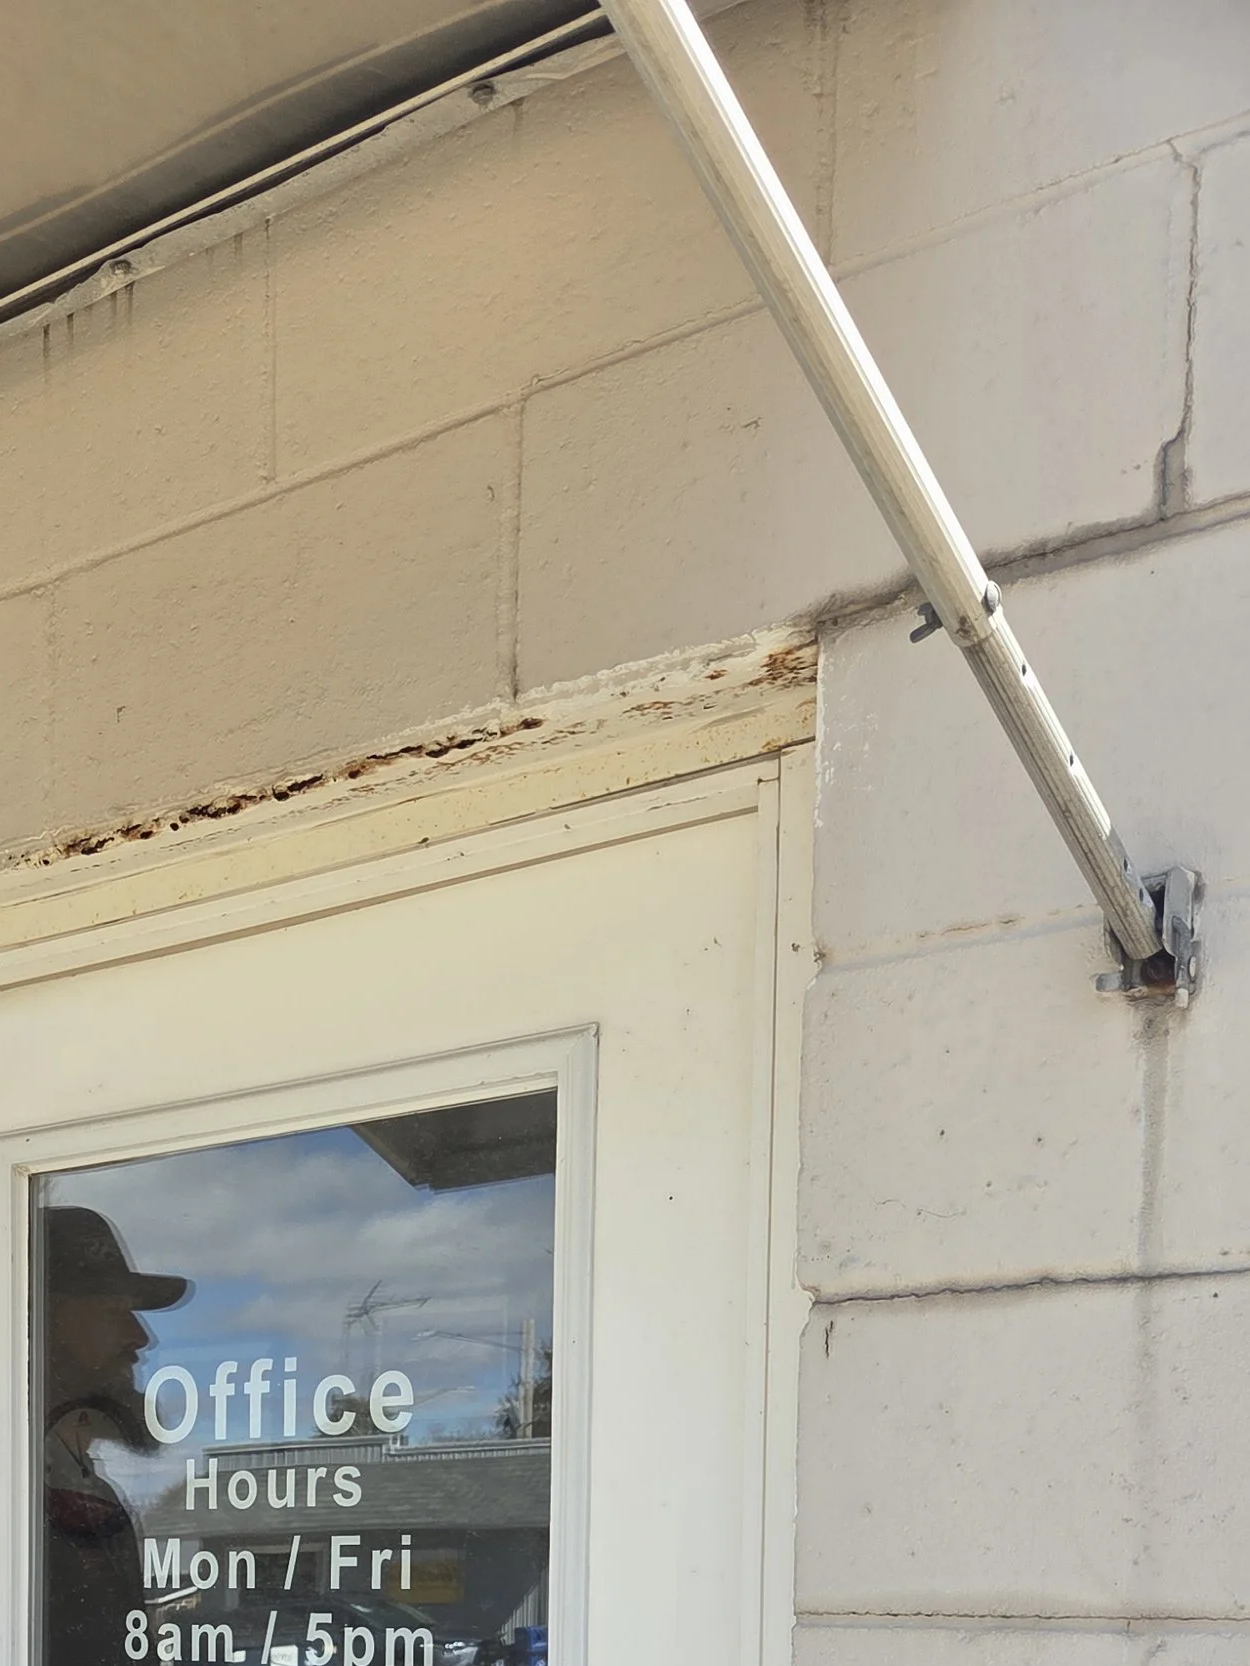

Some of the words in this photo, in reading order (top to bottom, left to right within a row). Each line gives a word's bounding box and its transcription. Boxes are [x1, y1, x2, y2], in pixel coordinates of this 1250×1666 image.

[143, 1357, 415, 1444] Office
[185, 1458, 363, 1510] Hours
[143, 1537, 256, 1590] Mon
[284, 1535, 301, 1590] /
[330, 1534, 412, 1590] Fri
[125, 1610, 233, 1662] 8am
[261, 1611, 277, 1664] /
